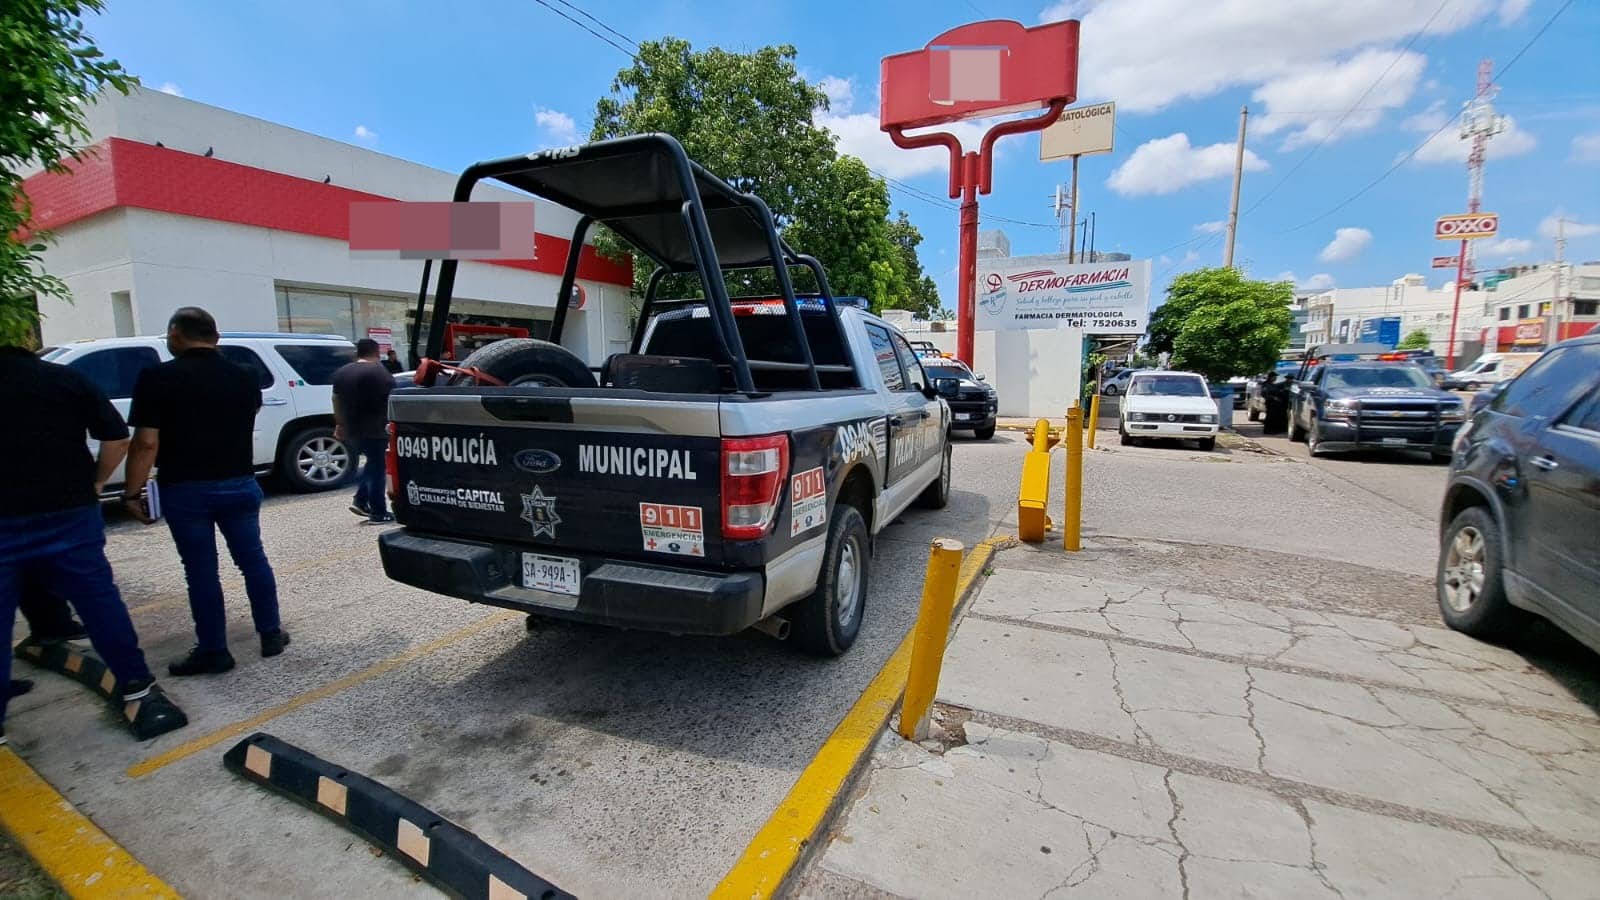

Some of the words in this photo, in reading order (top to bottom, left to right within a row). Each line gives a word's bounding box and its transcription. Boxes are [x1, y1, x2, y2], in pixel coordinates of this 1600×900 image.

[1440, 217, 1496, 235] OXXO
[1018, 267, 1130, 293] DERMOFARMACIA
[1015, 312, 1053, 320] FARMACIA
[1067, 318, 1087, 328] Tel:
[1092, 319, 1137, 328] 7520635
[396, 436, 429, 459] 0949
[431, 432, 498, 466] POLICÍA
[579, 444, 697, 480] MUNICIPAL
[794, 471, 822, 499] 911
[456, 488, 505, 505] CAPITAL
[645, 507, 696, 527] 911
[524, 561, 577, 584] SA-949A-1
